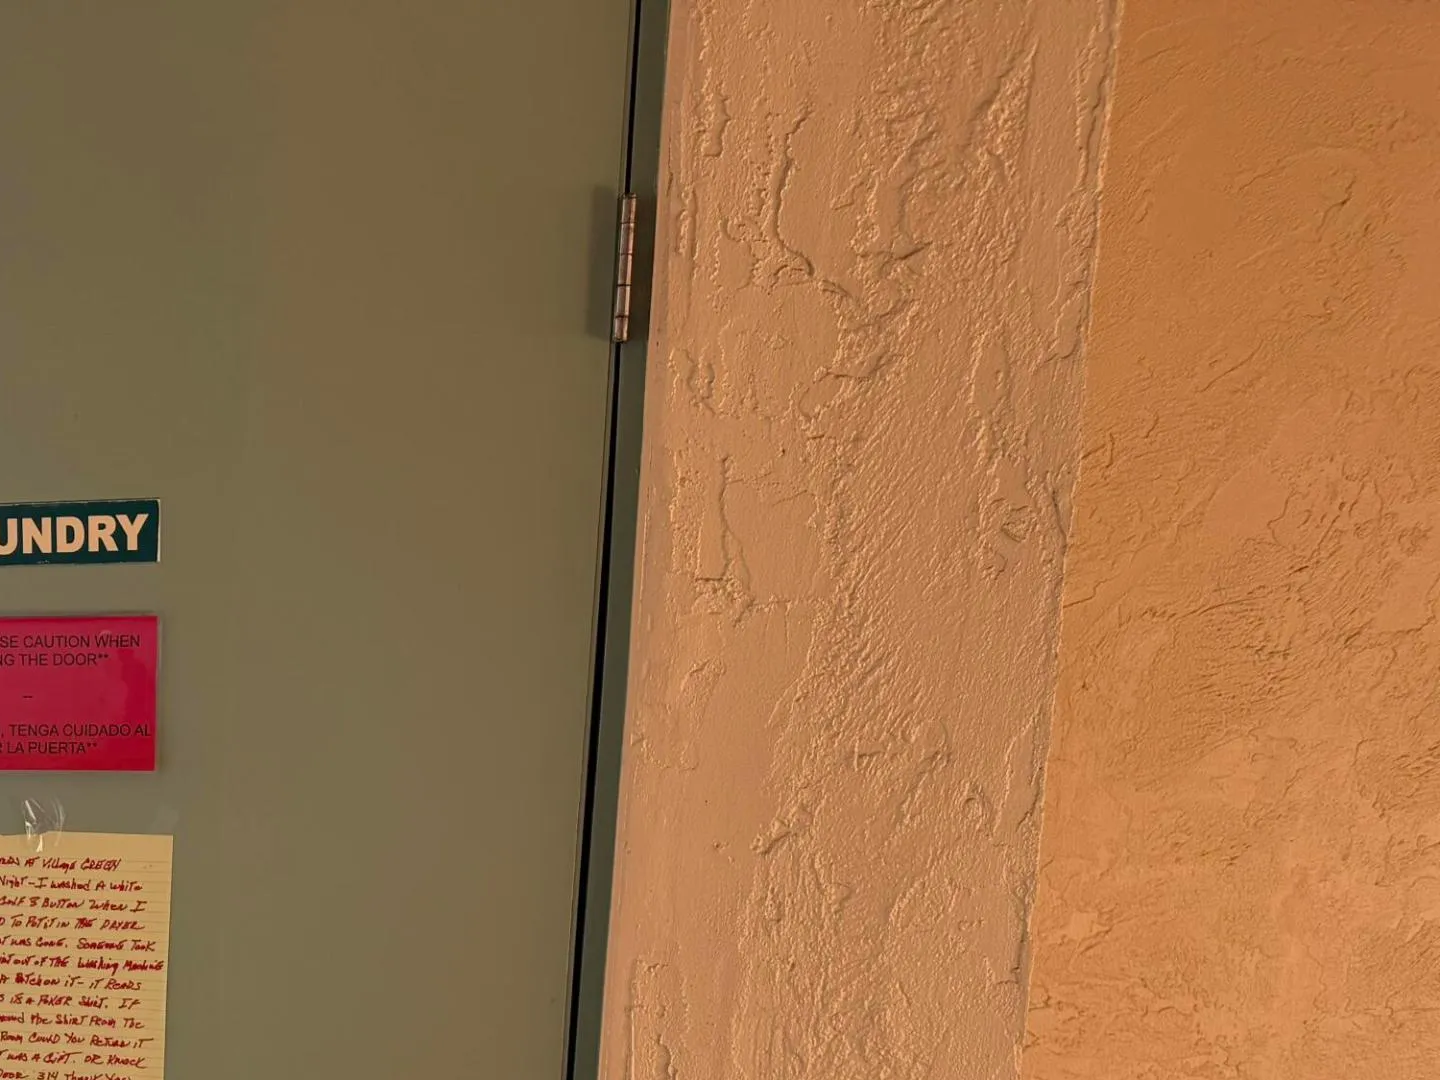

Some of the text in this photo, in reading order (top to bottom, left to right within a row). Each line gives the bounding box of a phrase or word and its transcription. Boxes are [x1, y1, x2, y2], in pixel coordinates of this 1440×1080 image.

[23, 635, 90, 648] CAUTION
[94, 634, 141, 648] WHEN
[18, 654, 48, 667] THE
[9, 724, 59, 737] TENGA
[62, 724, 131, 737] CUIDADO
[134, 724, 152, 737] AL
[7, 742, 25, 754] LA
[23, 856, 41, 867] AT
[80, 857, 122, 871] GREEN
